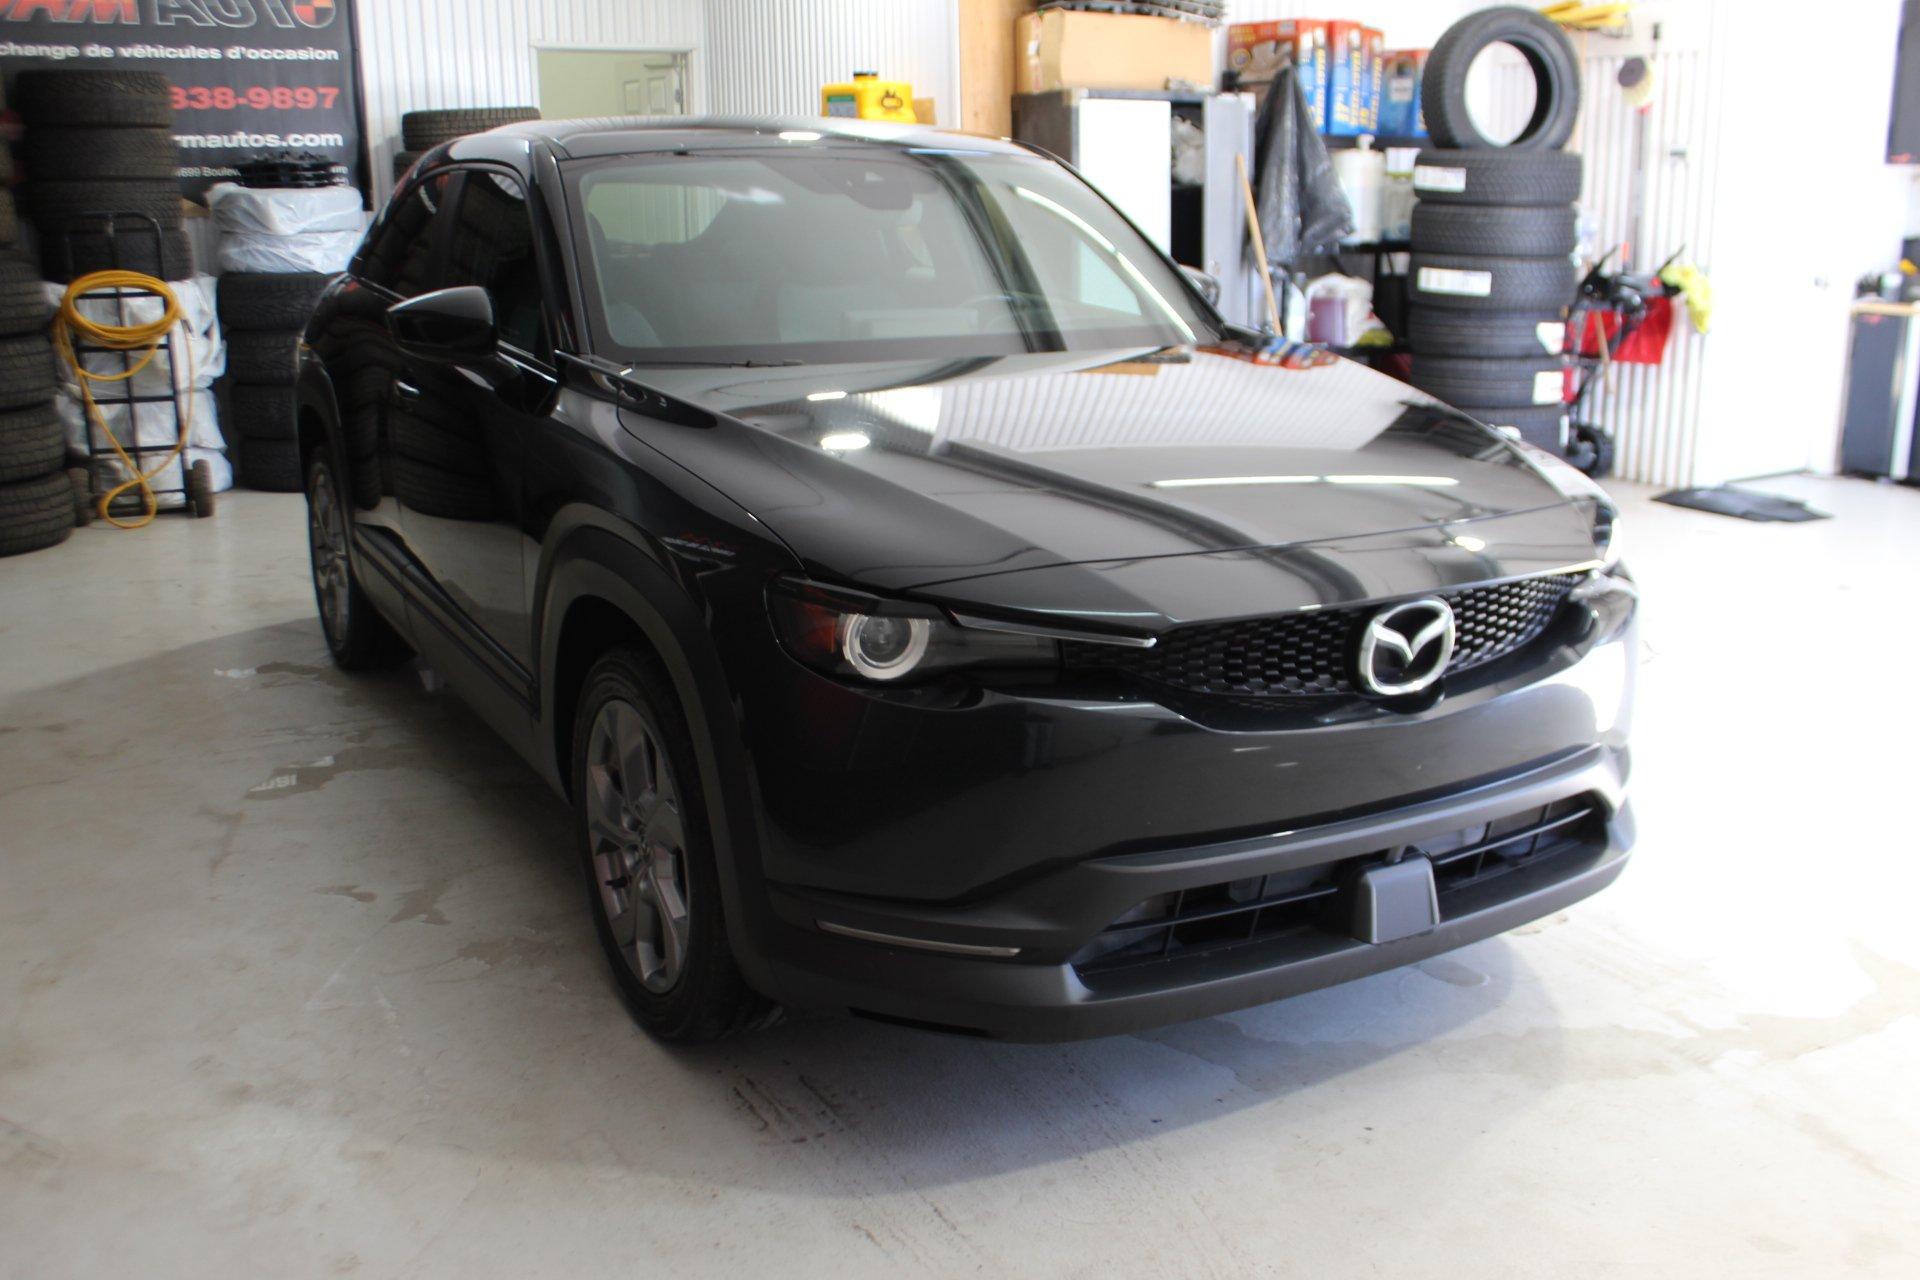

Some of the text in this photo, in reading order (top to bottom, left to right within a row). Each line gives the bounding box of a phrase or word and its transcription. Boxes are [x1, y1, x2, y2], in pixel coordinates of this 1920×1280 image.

[86, 43, 115, 58] de
[117, 43, 222, 61] véhicules
[226, 46, 339, 61] d'occasion
